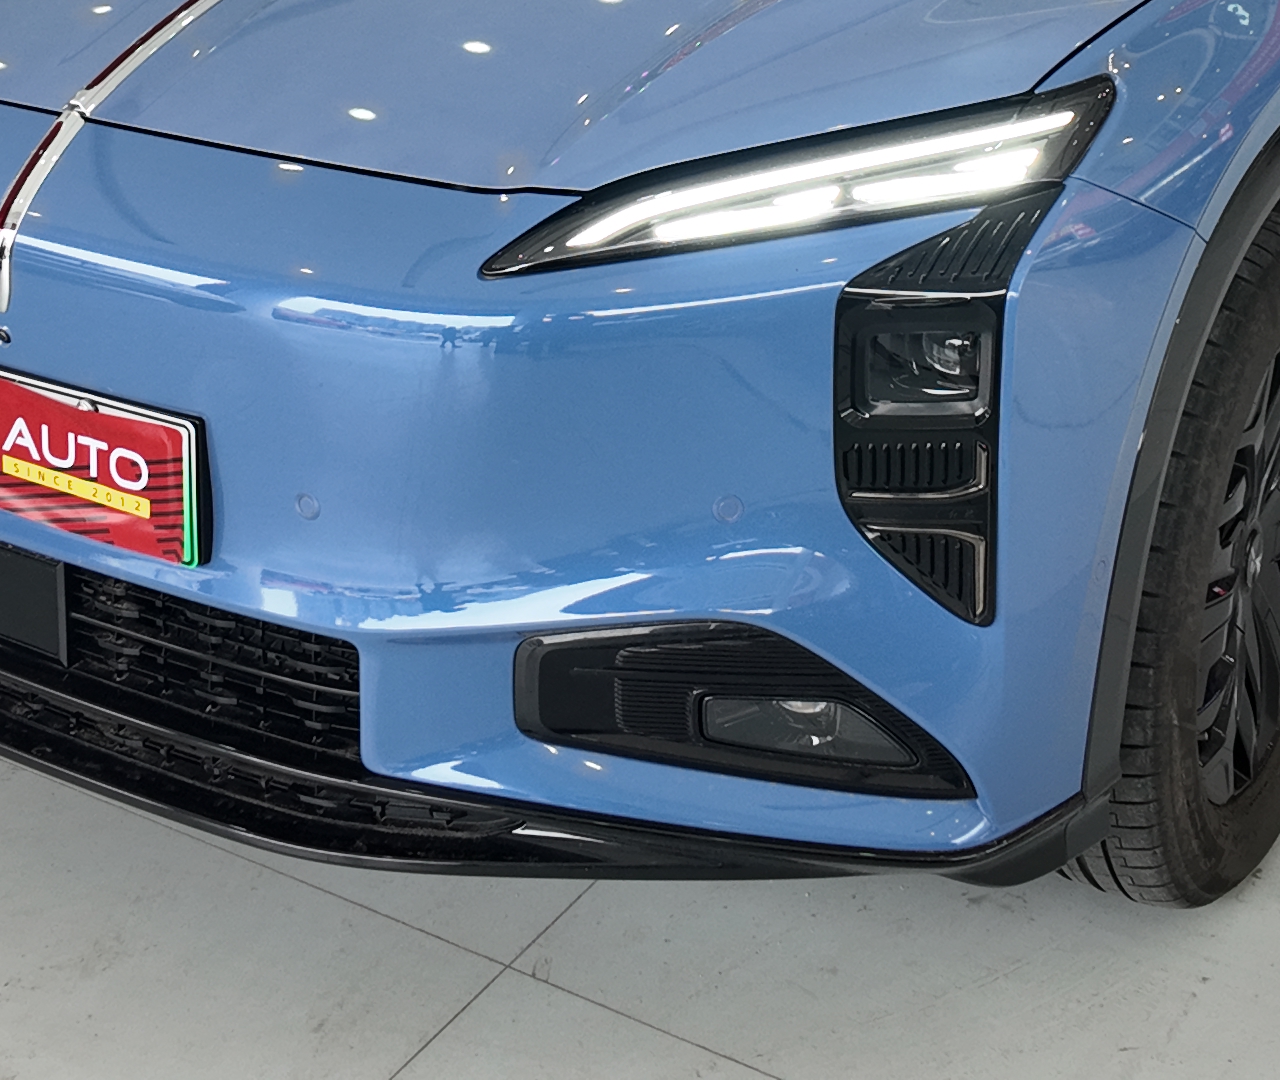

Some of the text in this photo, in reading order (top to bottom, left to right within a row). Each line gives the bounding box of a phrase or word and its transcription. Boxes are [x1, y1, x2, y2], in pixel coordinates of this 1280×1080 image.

[2, 416, 150, 491] AUTO
[12, 461, 143, 512] SINCE 2012
